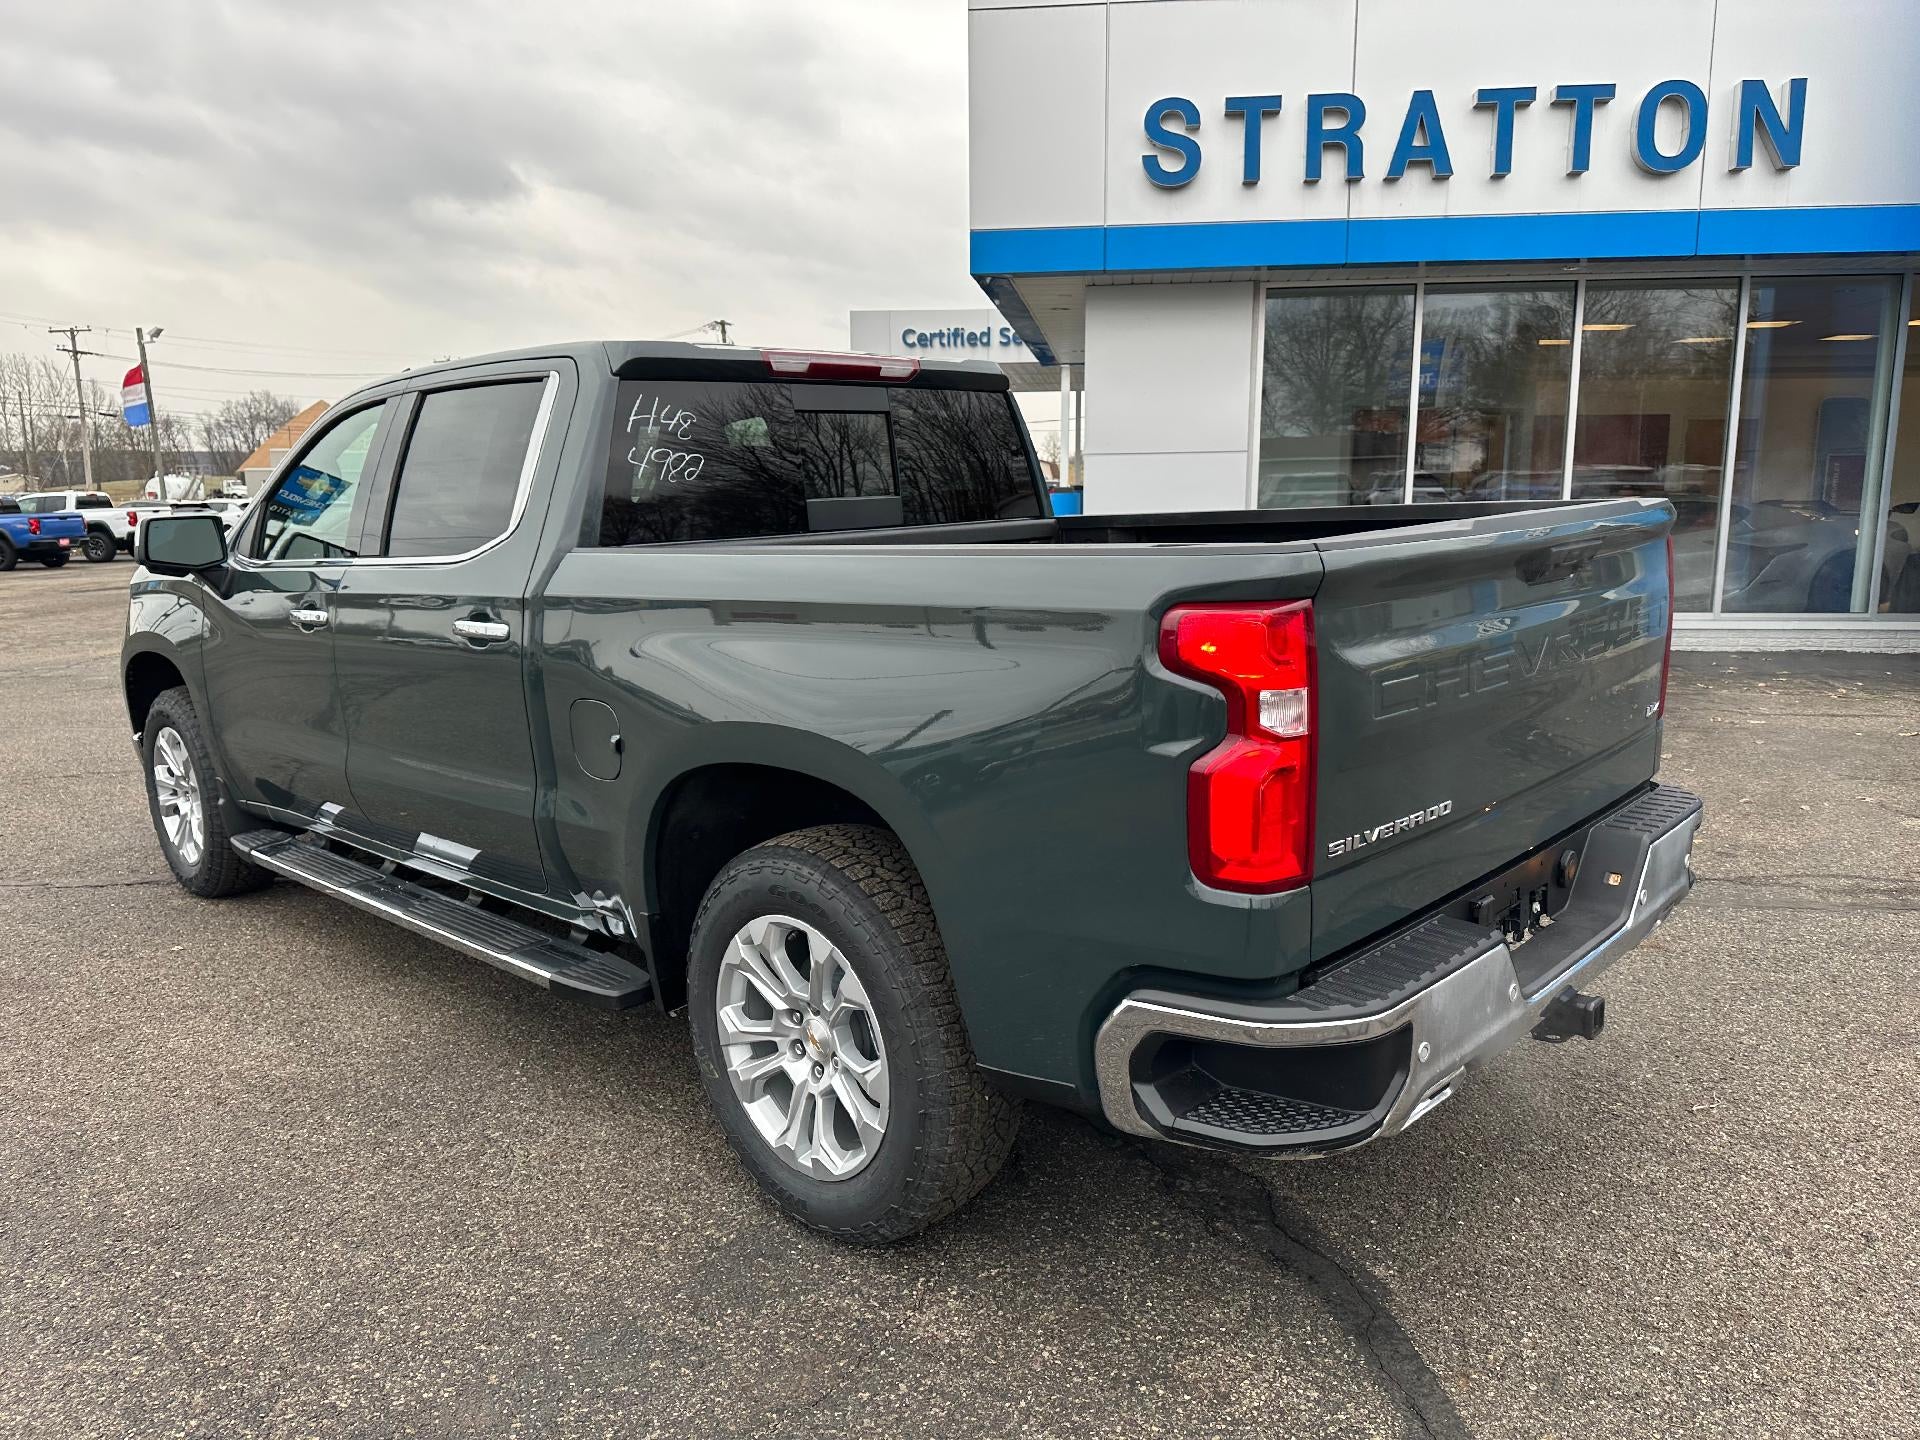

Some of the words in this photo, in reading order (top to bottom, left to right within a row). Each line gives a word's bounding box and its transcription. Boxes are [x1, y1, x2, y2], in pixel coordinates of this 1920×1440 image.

[1142, 77, 1808, 189] STRATTON
[901, 326, 991, 348] Certified
[627, 446, 704, 482] 4982
[1327, 799, 1452, 859] SILVERADO
